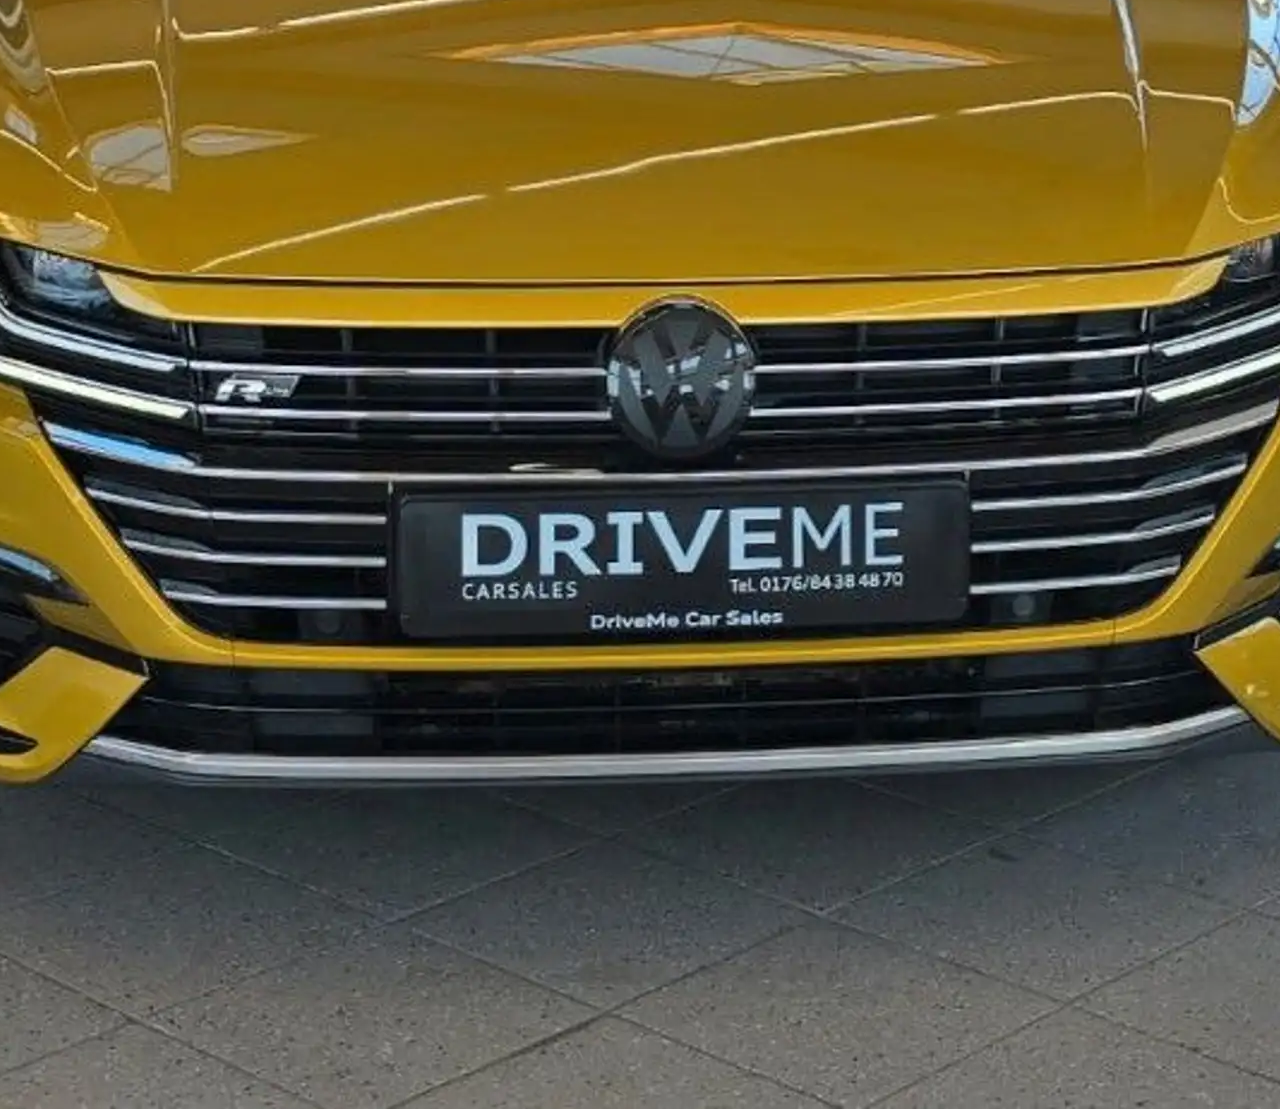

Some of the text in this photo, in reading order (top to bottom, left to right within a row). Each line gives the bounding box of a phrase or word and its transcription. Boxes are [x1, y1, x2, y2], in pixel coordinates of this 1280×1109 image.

[460, 501, 904, 578] DRIVEME
[461, 581, 579, 600] CARSALES
[590, 609, 784, 630] DriveMe Car Sales
